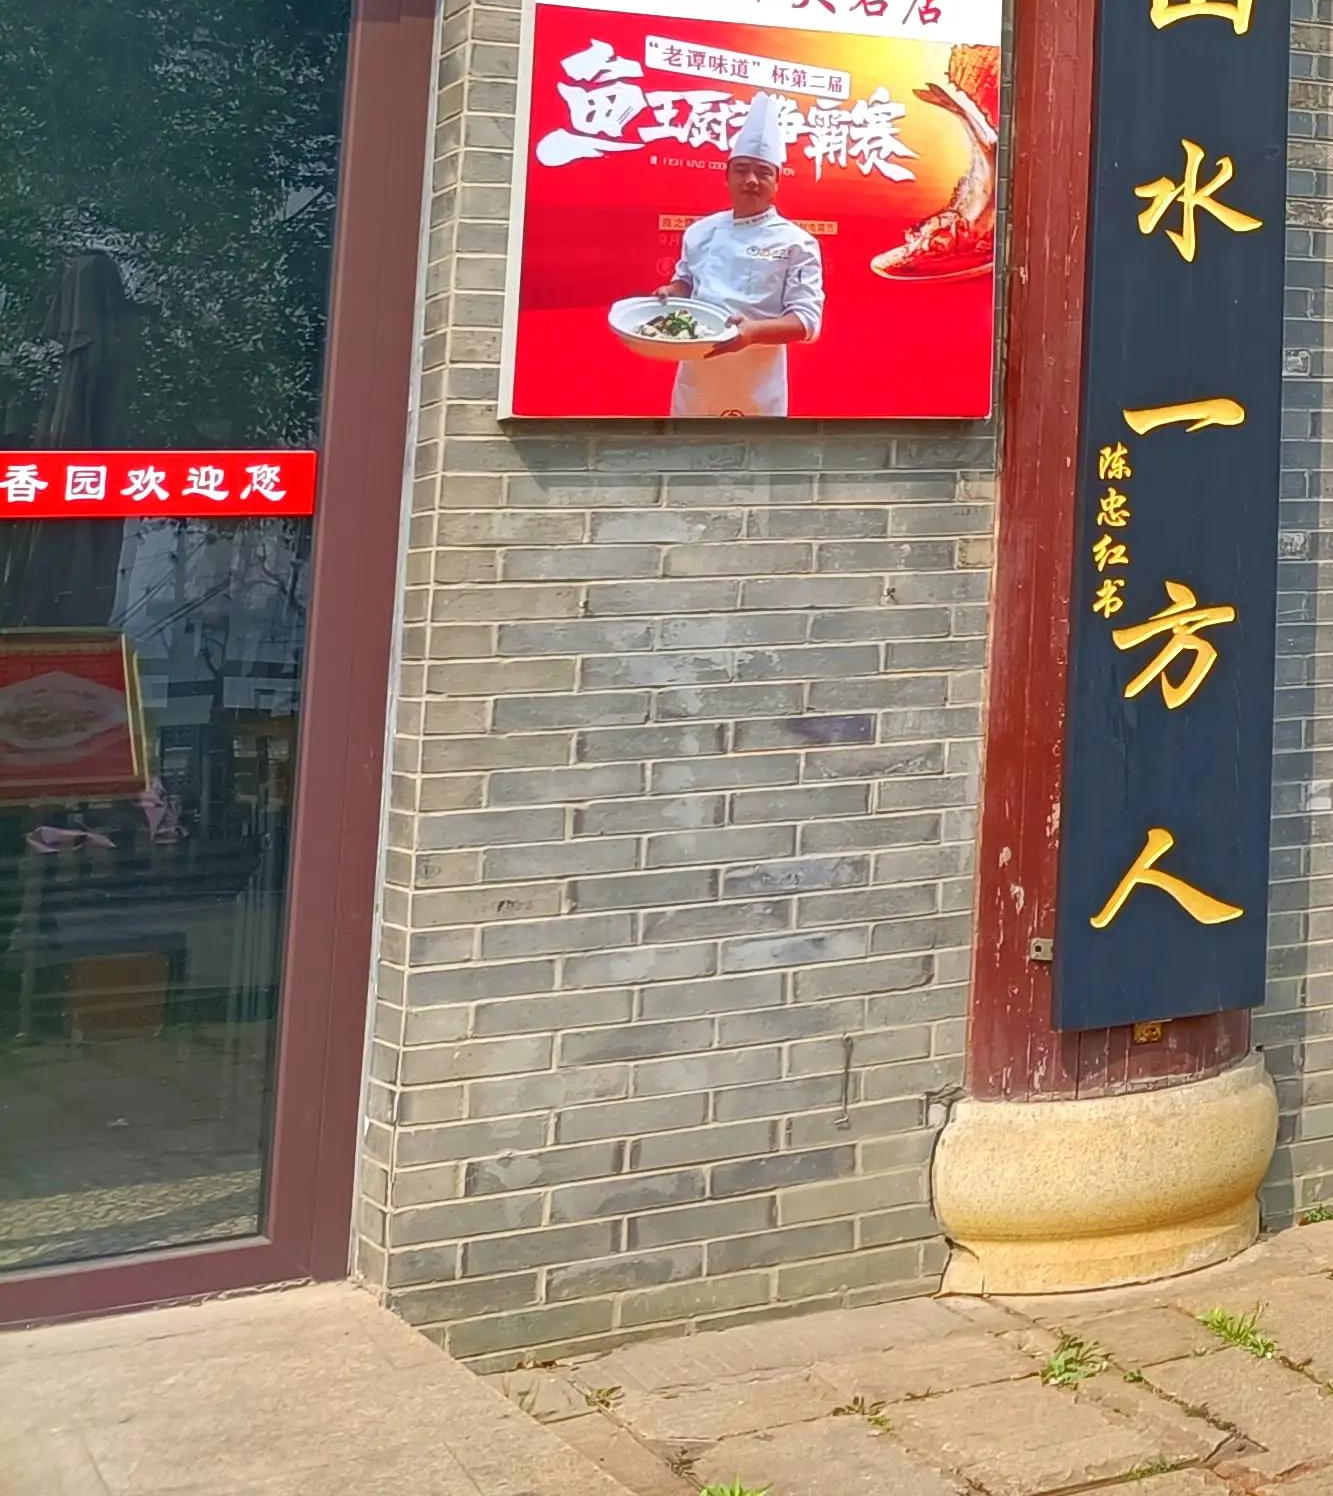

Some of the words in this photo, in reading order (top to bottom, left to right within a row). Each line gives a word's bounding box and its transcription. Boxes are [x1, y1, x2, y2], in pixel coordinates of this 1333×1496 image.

[536, 38, 921, 183] 鱼王厨争霸赛
[1092, 441, 1132, 619] 陈忠红书
